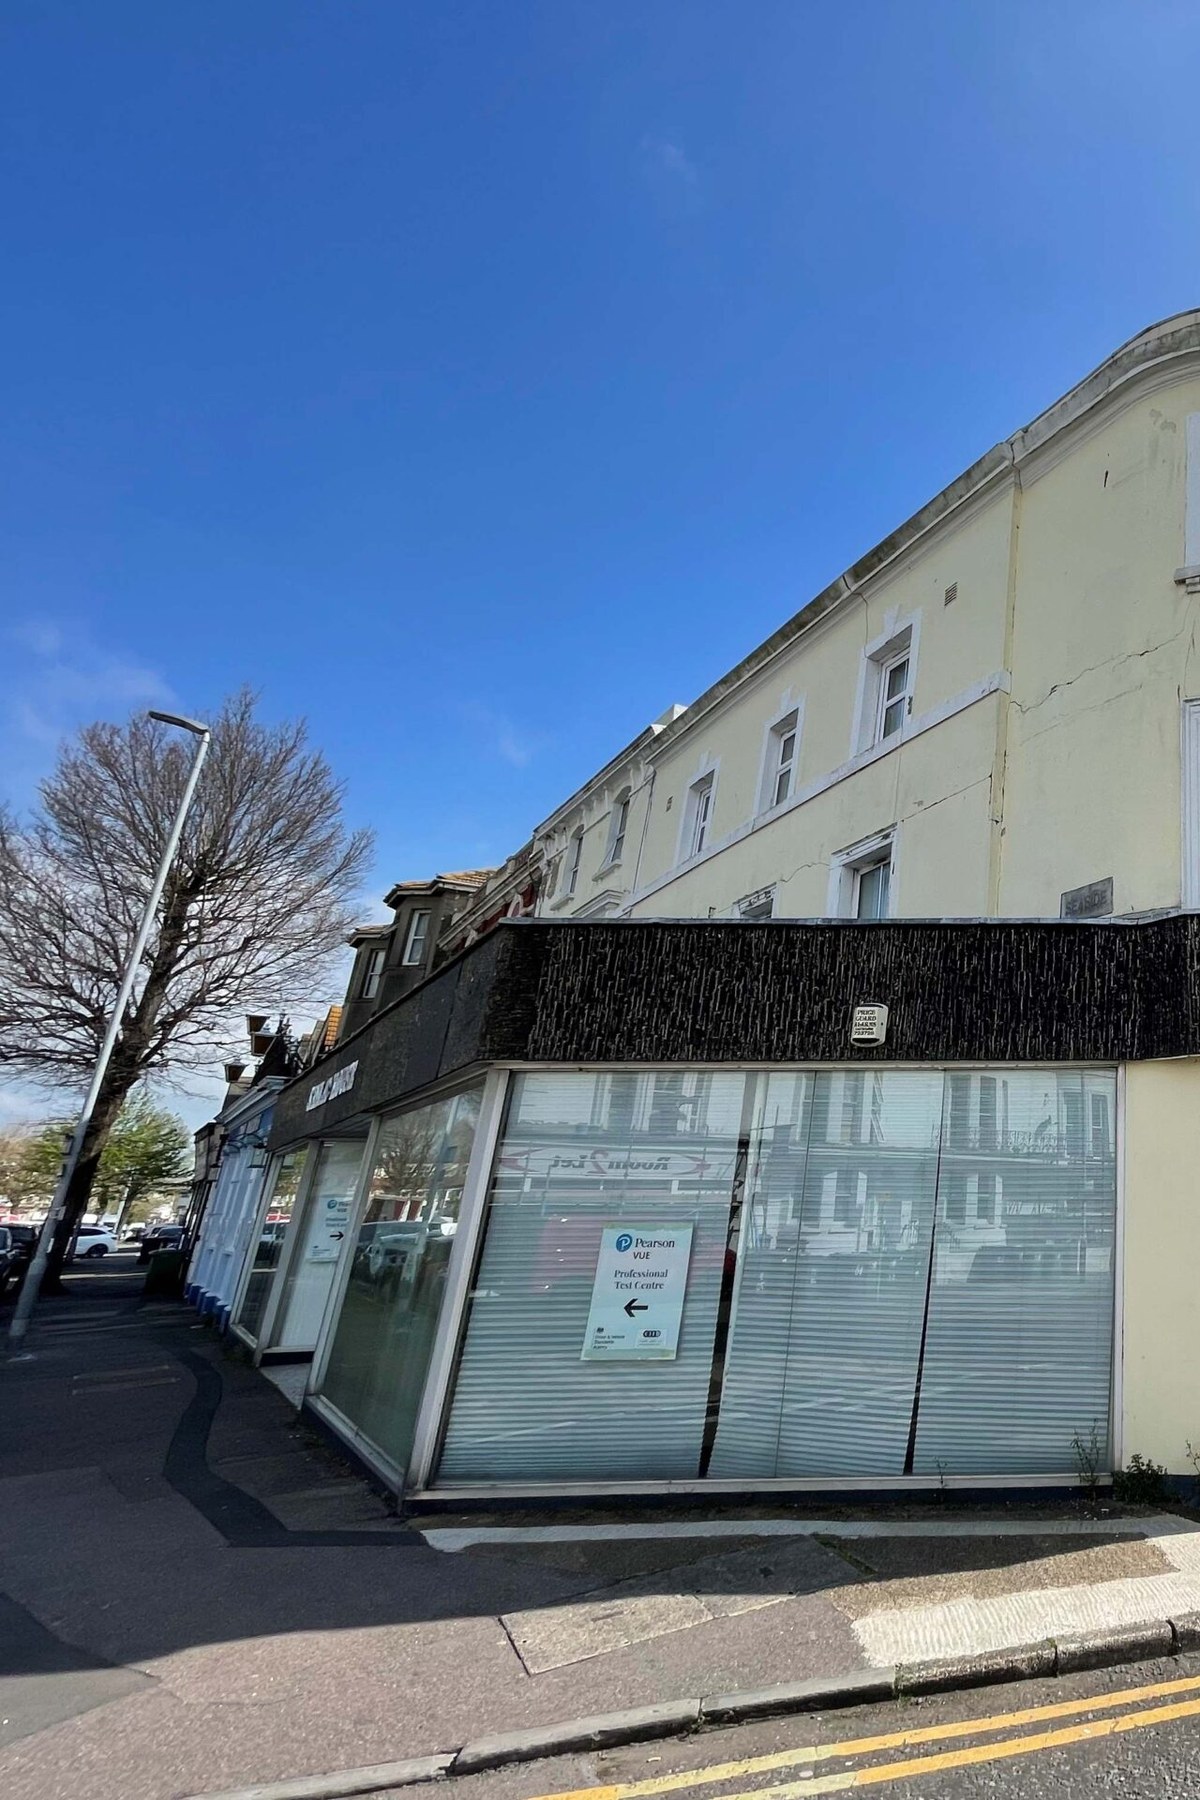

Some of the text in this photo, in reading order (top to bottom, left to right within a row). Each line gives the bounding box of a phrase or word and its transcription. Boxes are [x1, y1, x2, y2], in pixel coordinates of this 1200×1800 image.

[634, 1238, 675, 1248] Pearson
[614, 1269, 669, 1278] Professional
[614, 1281, 664, 1290] Test Centre
